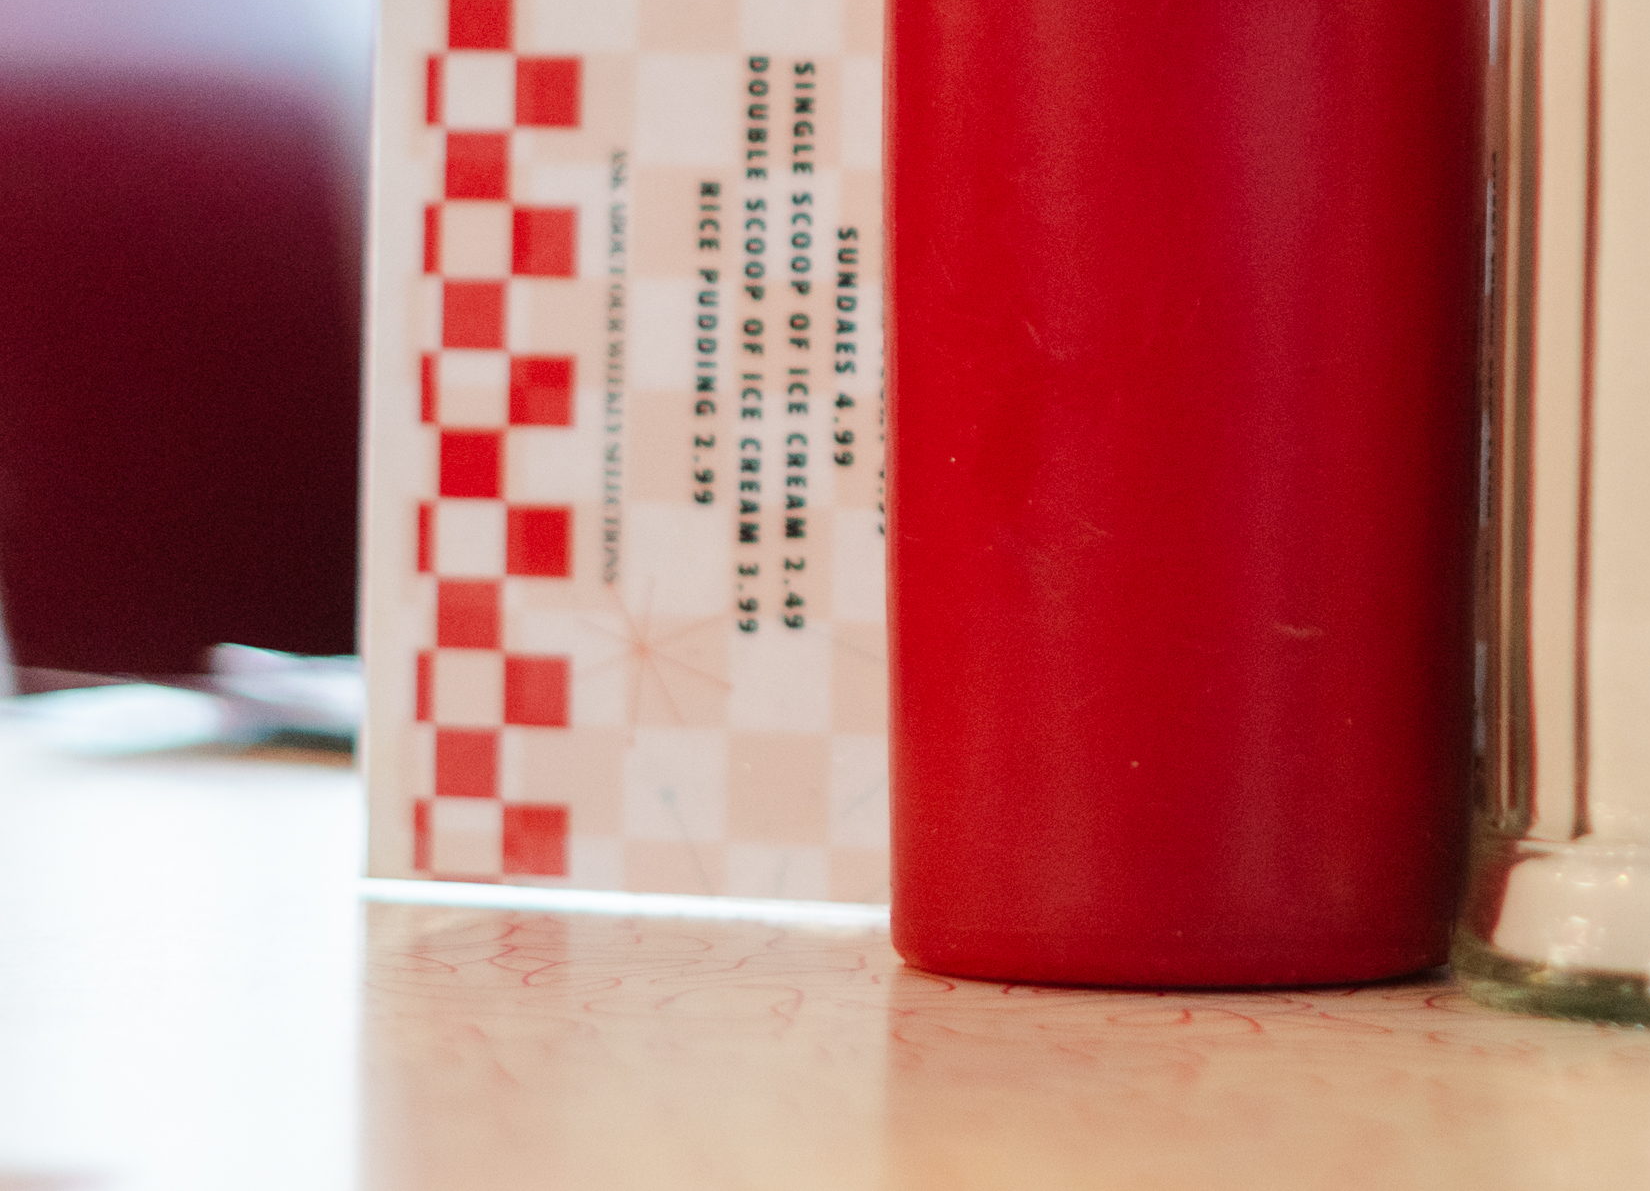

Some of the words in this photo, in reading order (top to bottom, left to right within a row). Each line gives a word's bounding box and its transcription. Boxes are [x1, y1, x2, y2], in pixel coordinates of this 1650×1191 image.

[747, 56, 769, 179] DOUBLE
[793, 62, 815, 174] SINGLE
[699, 182, 721, 250] RICE
[744, 198, 766, 300] SCOOP
[791, 193, 813, 296] SCOOP
[743, 319, 764, 354] OF
[789, 313, 811, 350] OF
[835, 228, 858, 374] SUNDAES
[695, 269, 719, 416] PUDDING
[741, 373, 763, 419] ICE
[787, 368, 809, 414] ICE
[834, 394, 856, 467] 4.99
[694, 435, 716, 505] 2.99
[738, 438, 761, 544] CREAM
[785, 433, 807, 539] CREAM
[737, 563, 759, 634] 3.99
[783, 557, 805, 630] 2.49
